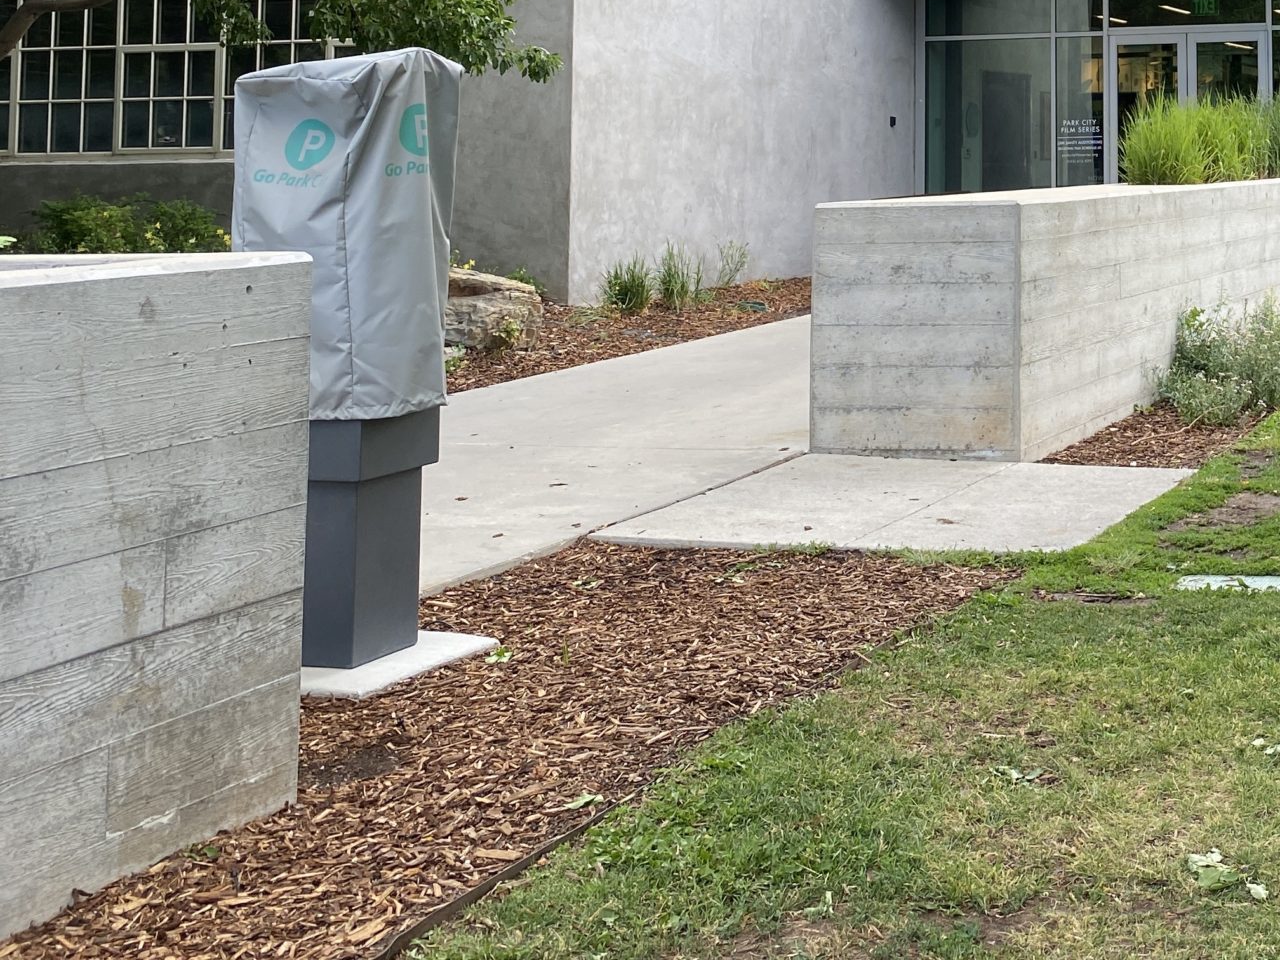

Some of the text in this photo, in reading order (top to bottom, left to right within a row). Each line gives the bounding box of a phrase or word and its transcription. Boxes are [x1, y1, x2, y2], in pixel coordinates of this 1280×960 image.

[298, 129, 327, 163] P
[254, 168, 276, 184] Go
[276, 171, 314, 187] Park
[384, 162, 403, 177] Go
